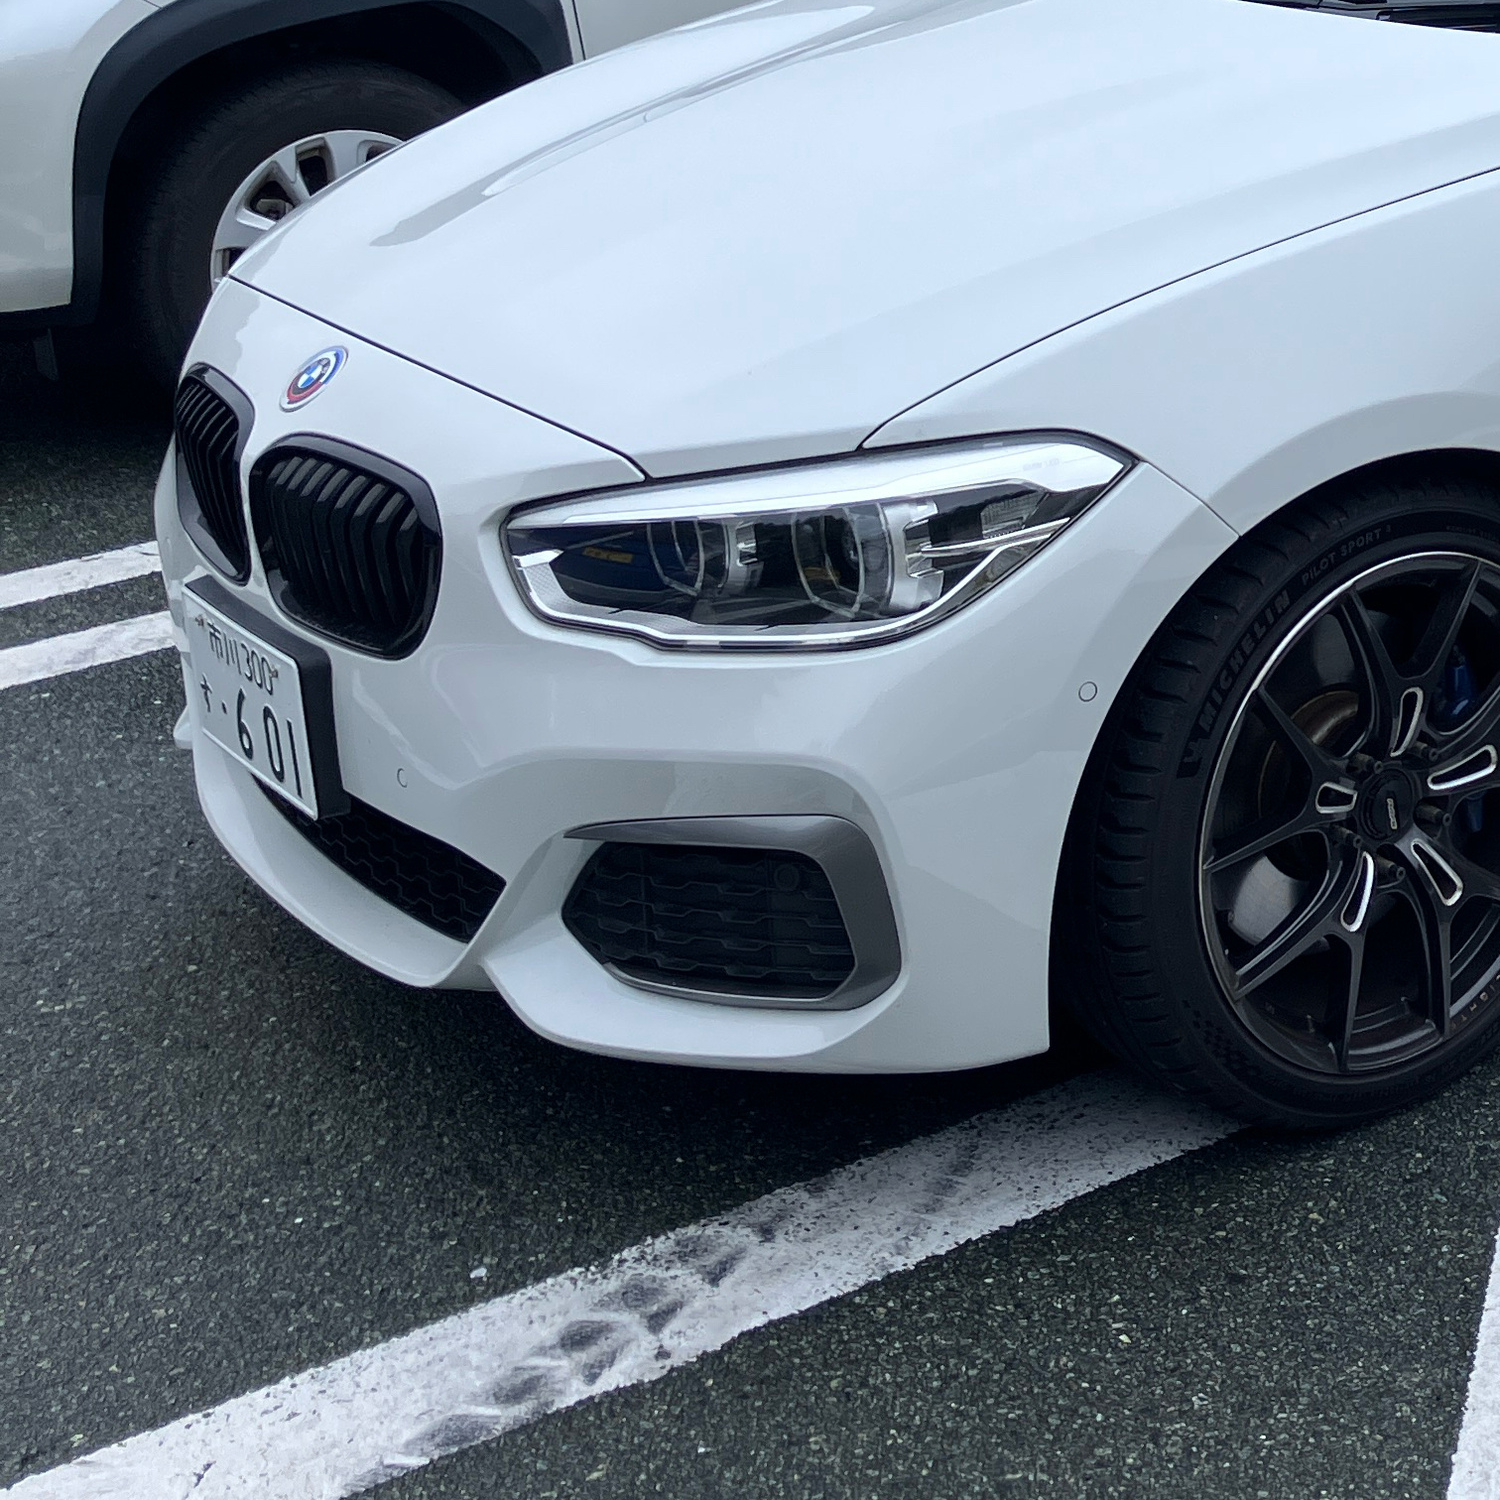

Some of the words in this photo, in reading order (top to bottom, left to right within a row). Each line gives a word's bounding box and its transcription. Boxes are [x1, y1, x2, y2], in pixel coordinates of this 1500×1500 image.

[1196, 587, 1292, 734] MICHELIN
[1300, 551, 1338, 587] PILOT
[1339, 526, 1382, 558] SPORT
